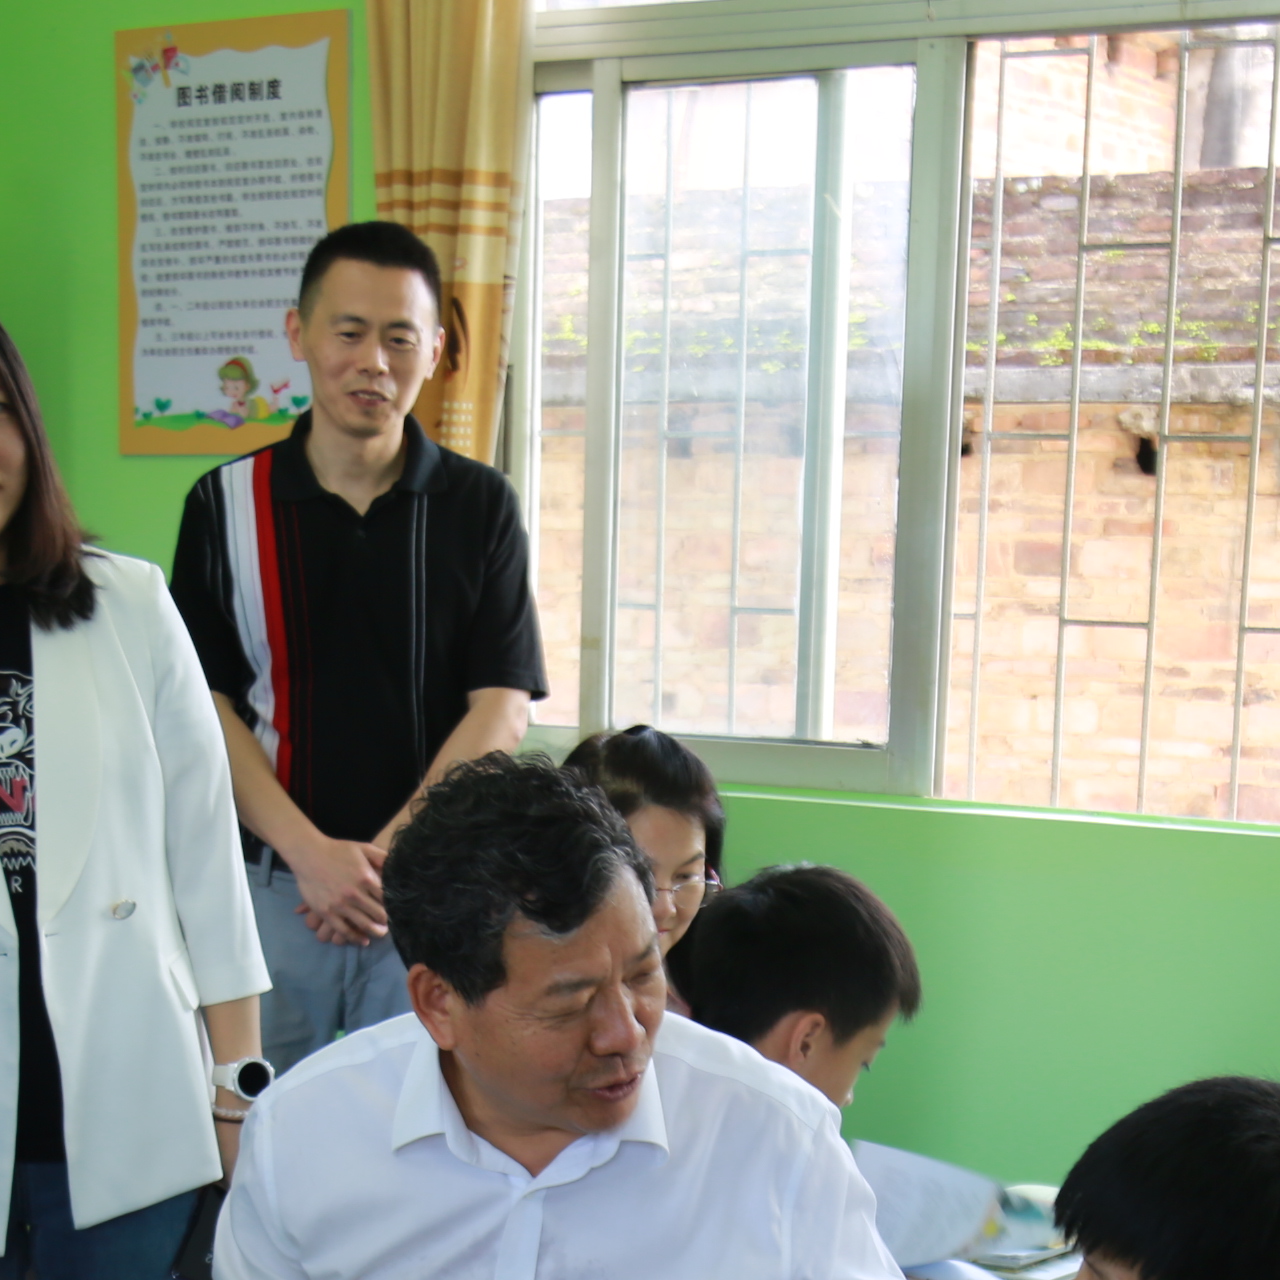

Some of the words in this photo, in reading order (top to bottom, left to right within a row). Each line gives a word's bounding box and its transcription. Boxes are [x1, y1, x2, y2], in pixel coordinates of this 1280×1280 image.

[175, 77, 283, 108] 图书借阅制度
